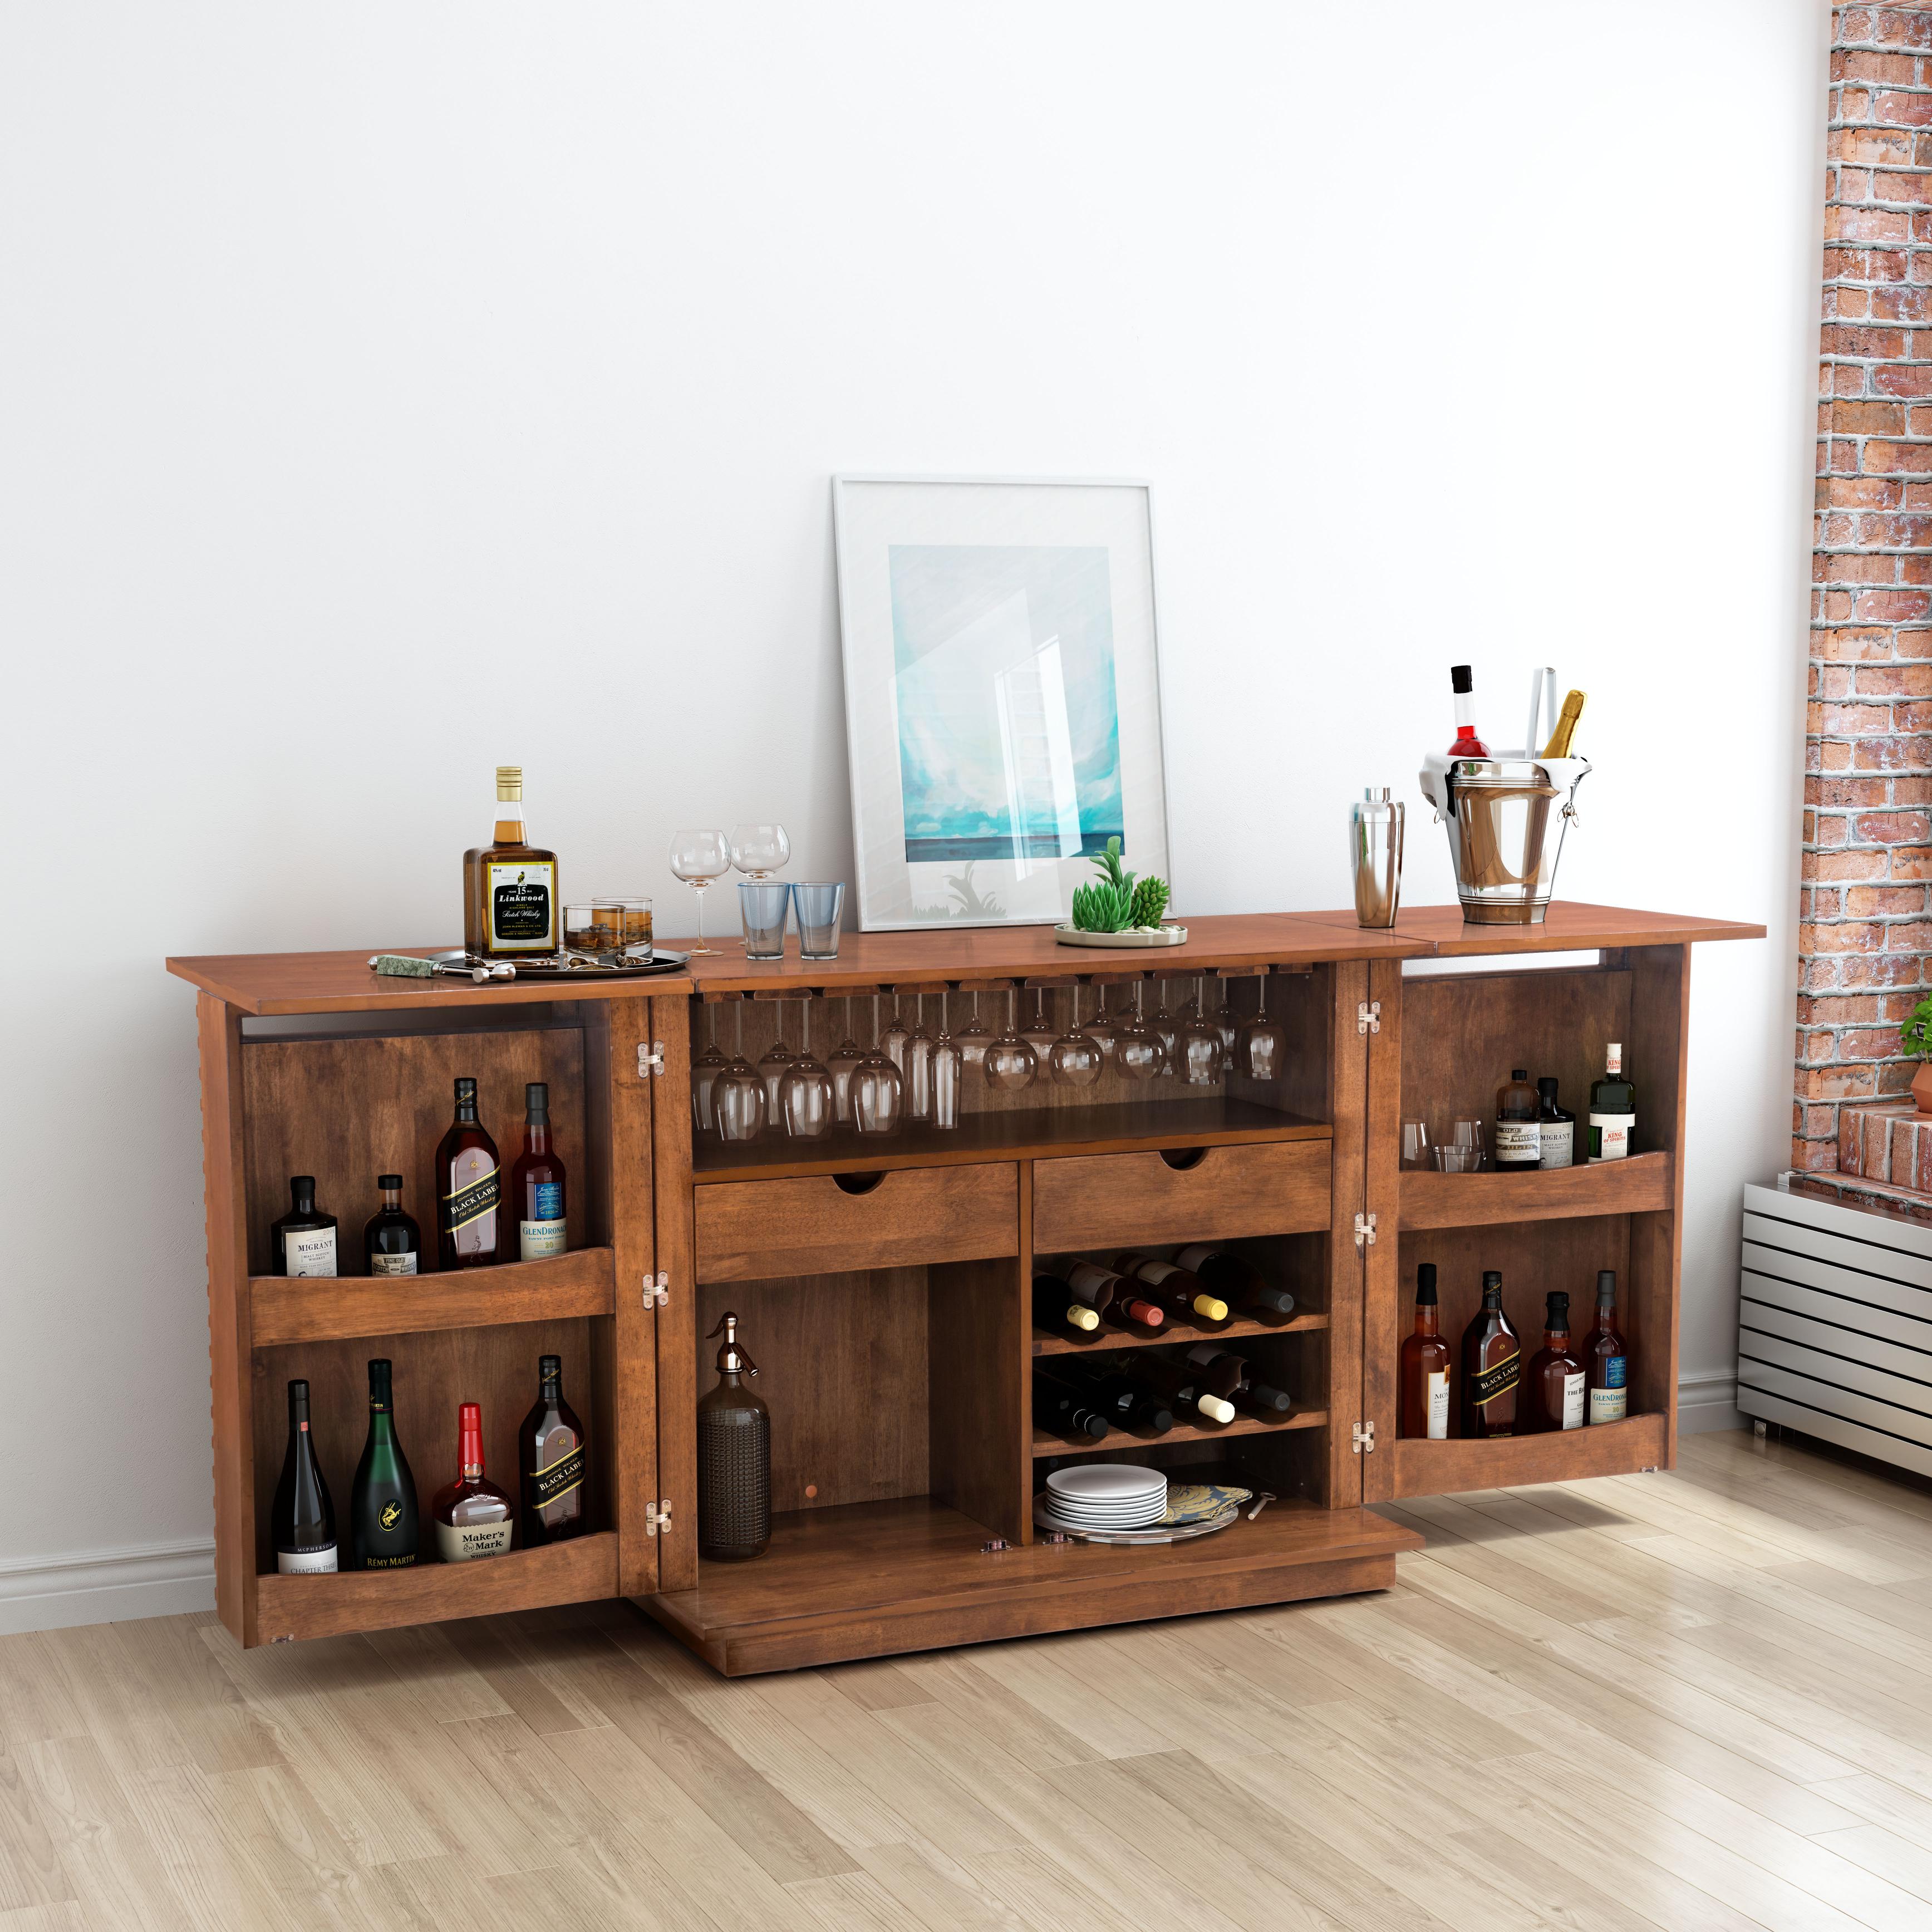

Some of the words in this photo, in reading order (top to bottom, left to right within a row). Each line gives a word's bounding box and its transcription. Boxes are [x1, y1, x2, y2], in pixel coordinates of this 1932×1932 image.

[517, 887, 526, 895] 15
[520, 910, 540, 919] Whisky
[450, 1197, 476, 1214] BLACK
[476, 1183, 499, 1200] LABEL
[457, 1191, 474, 1202] JOHNNIE
[475, 1182, 492, 1192] WALKER
[467, 1204, 480, 1214] Scotch
[480, 1196, 495, 1206] Whisky
[298, 1240, 333, 1252] MIGRANT
[373, 1264, 389, 1272] SCOTCH
[1487, 1370, 1500, 1379] JOHNNIE
[1501, 1361, 1515, 1370] WALKER
[1481, 1374, 1502, 1389] BLACK
[1495, 1380, 1505, 1389] Scotch
[1505, 1373, 1517, 1382] Whisky
[545, 1467, 562, 1479] JOHNNIE
[562, 1457, 578, 1468] WALKER
[539, 1472, 564, 1491] BLACK
[555, 1480, 567, 1489] Scotch
[568, 1471, 582, 1481] Whisky
[462, 1532, 504, 1542] Maker's
[475, 1540, 503, 1550] Mark
[323, 1562, 337, 1571] THREE
[367, 1558, 388, 1566] RÉMY
[390, 1554, 415, 1566] MARTIN
